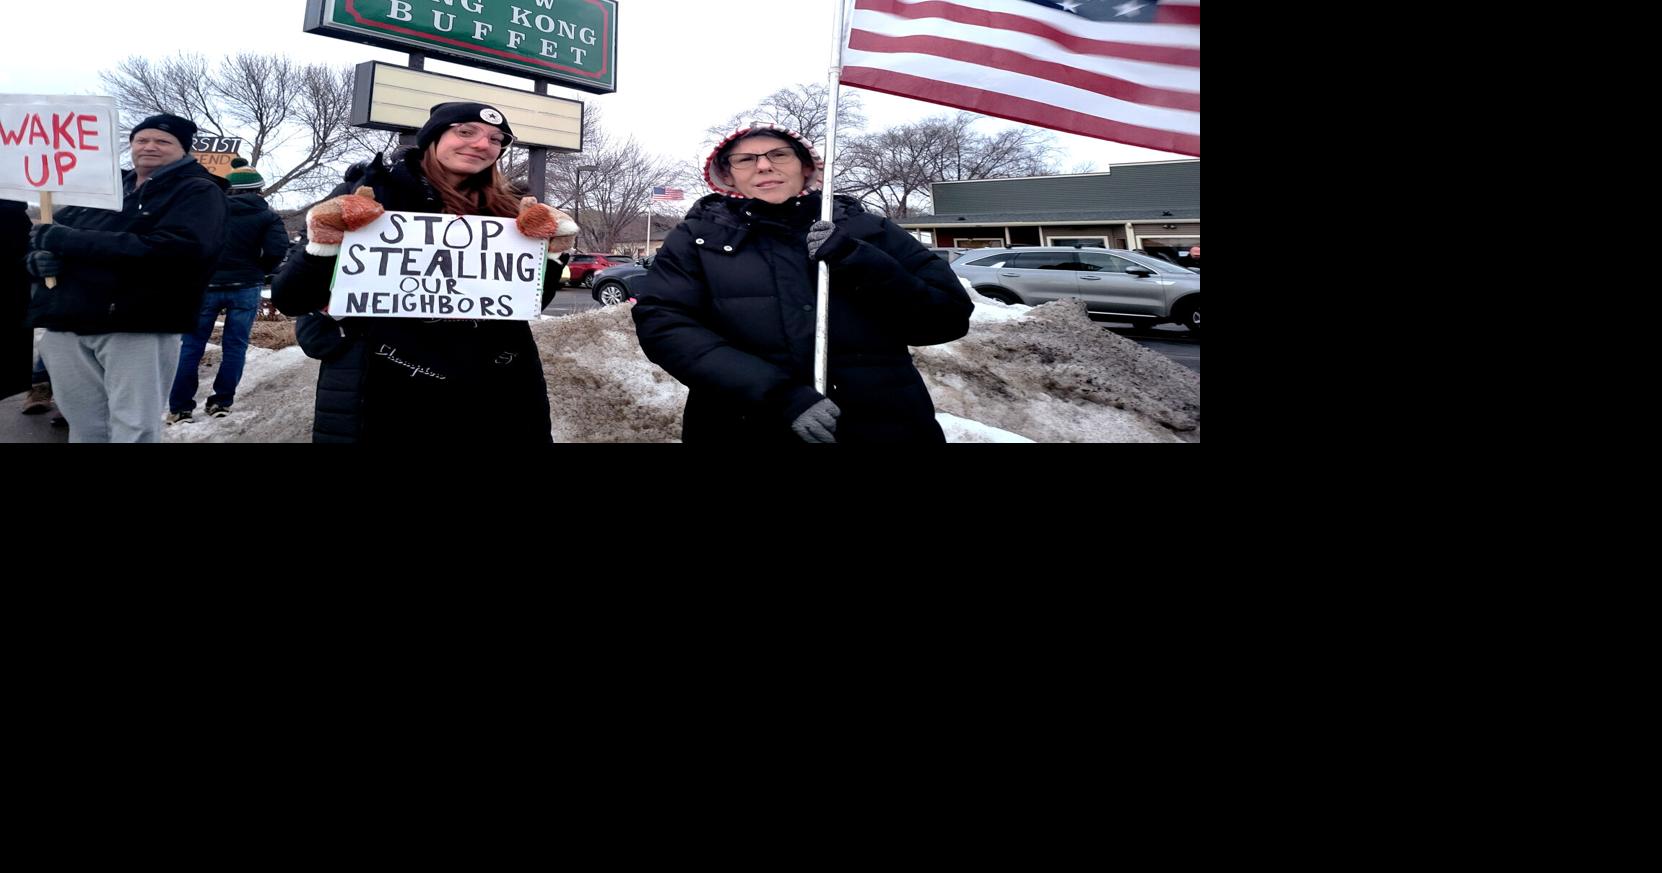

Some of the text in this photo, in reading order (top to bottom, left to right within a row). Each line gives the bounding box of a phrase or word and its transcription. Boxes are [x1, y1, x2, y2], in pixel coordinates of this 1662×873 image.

[386, 0, 587, 65] BUFFET
[511, 5, 597, 46] KONG
[0, 111, 99, 151] WAKE
[24, 151, 77, 188] UP
[195, 154, 231, 165] END
[379, 213, 504, 250] STOP
[341, 243, 536, 282] STEALING
[399, 276, 464, 295] OUR
[345, 292, 514, 317] NEIGHBORS
